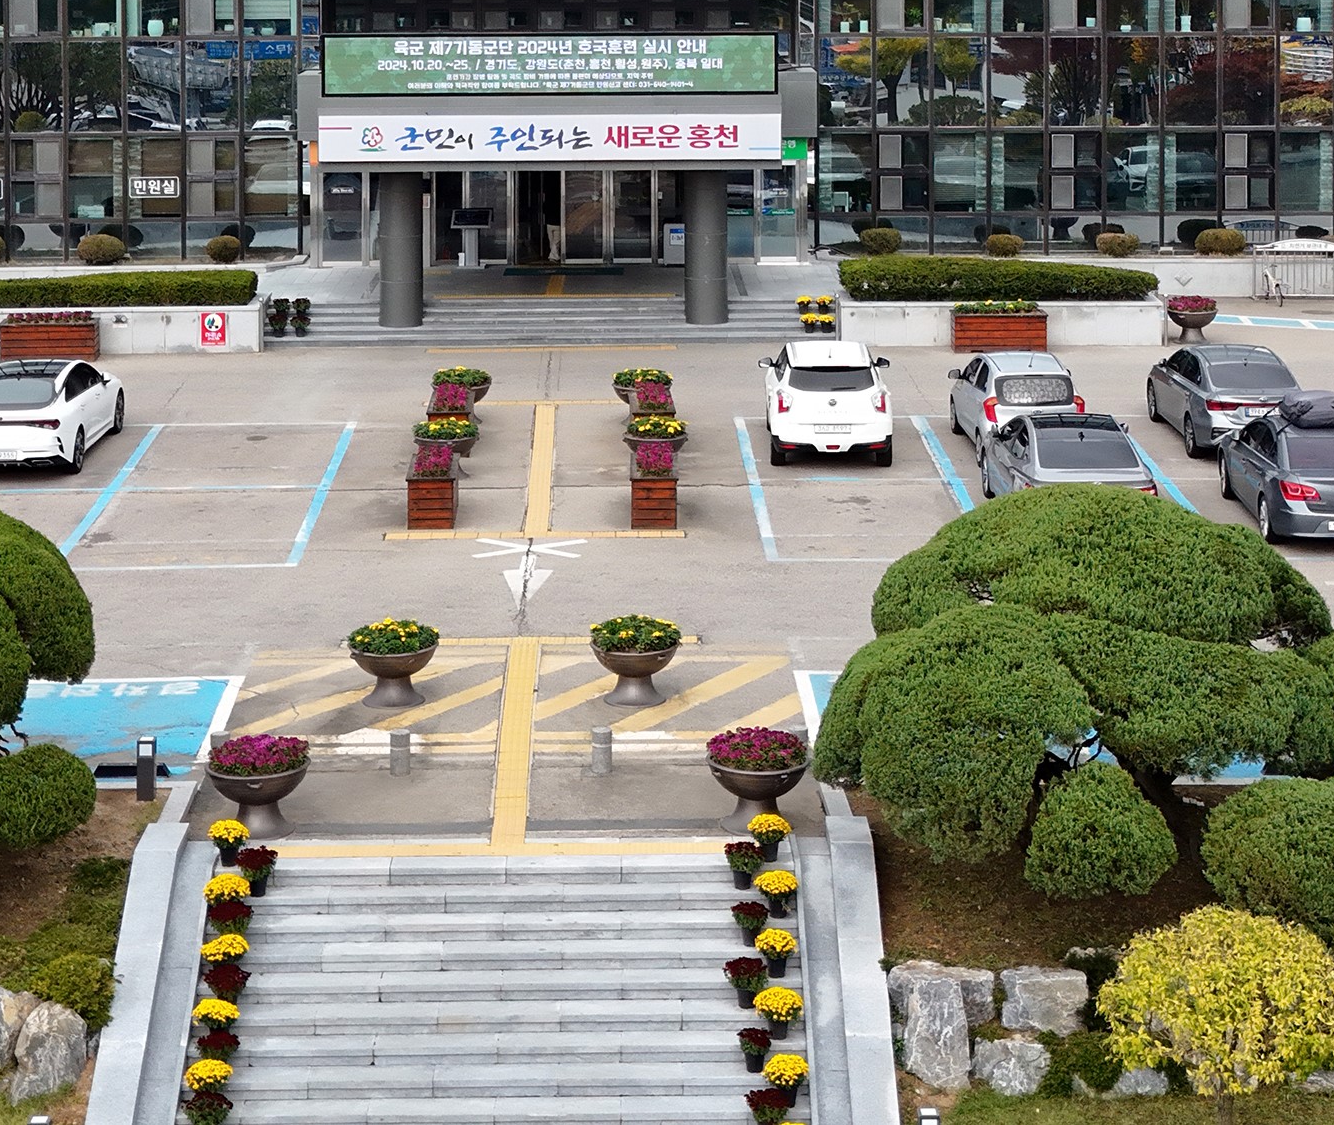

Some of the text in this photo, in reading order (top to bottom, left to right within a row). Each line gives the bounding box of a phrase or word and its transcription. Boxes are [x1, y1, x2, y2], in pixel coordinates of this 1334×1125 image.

[394, 39, 707, 56] 육군 제7기동군단 2024년 호국훈련 실시 안내
[700, 58, 723, 69] 일대
[395, 124, 739, 152] 군민이 주인되는 새로운 홍천
[134, 177, 175, 195] 민원실
